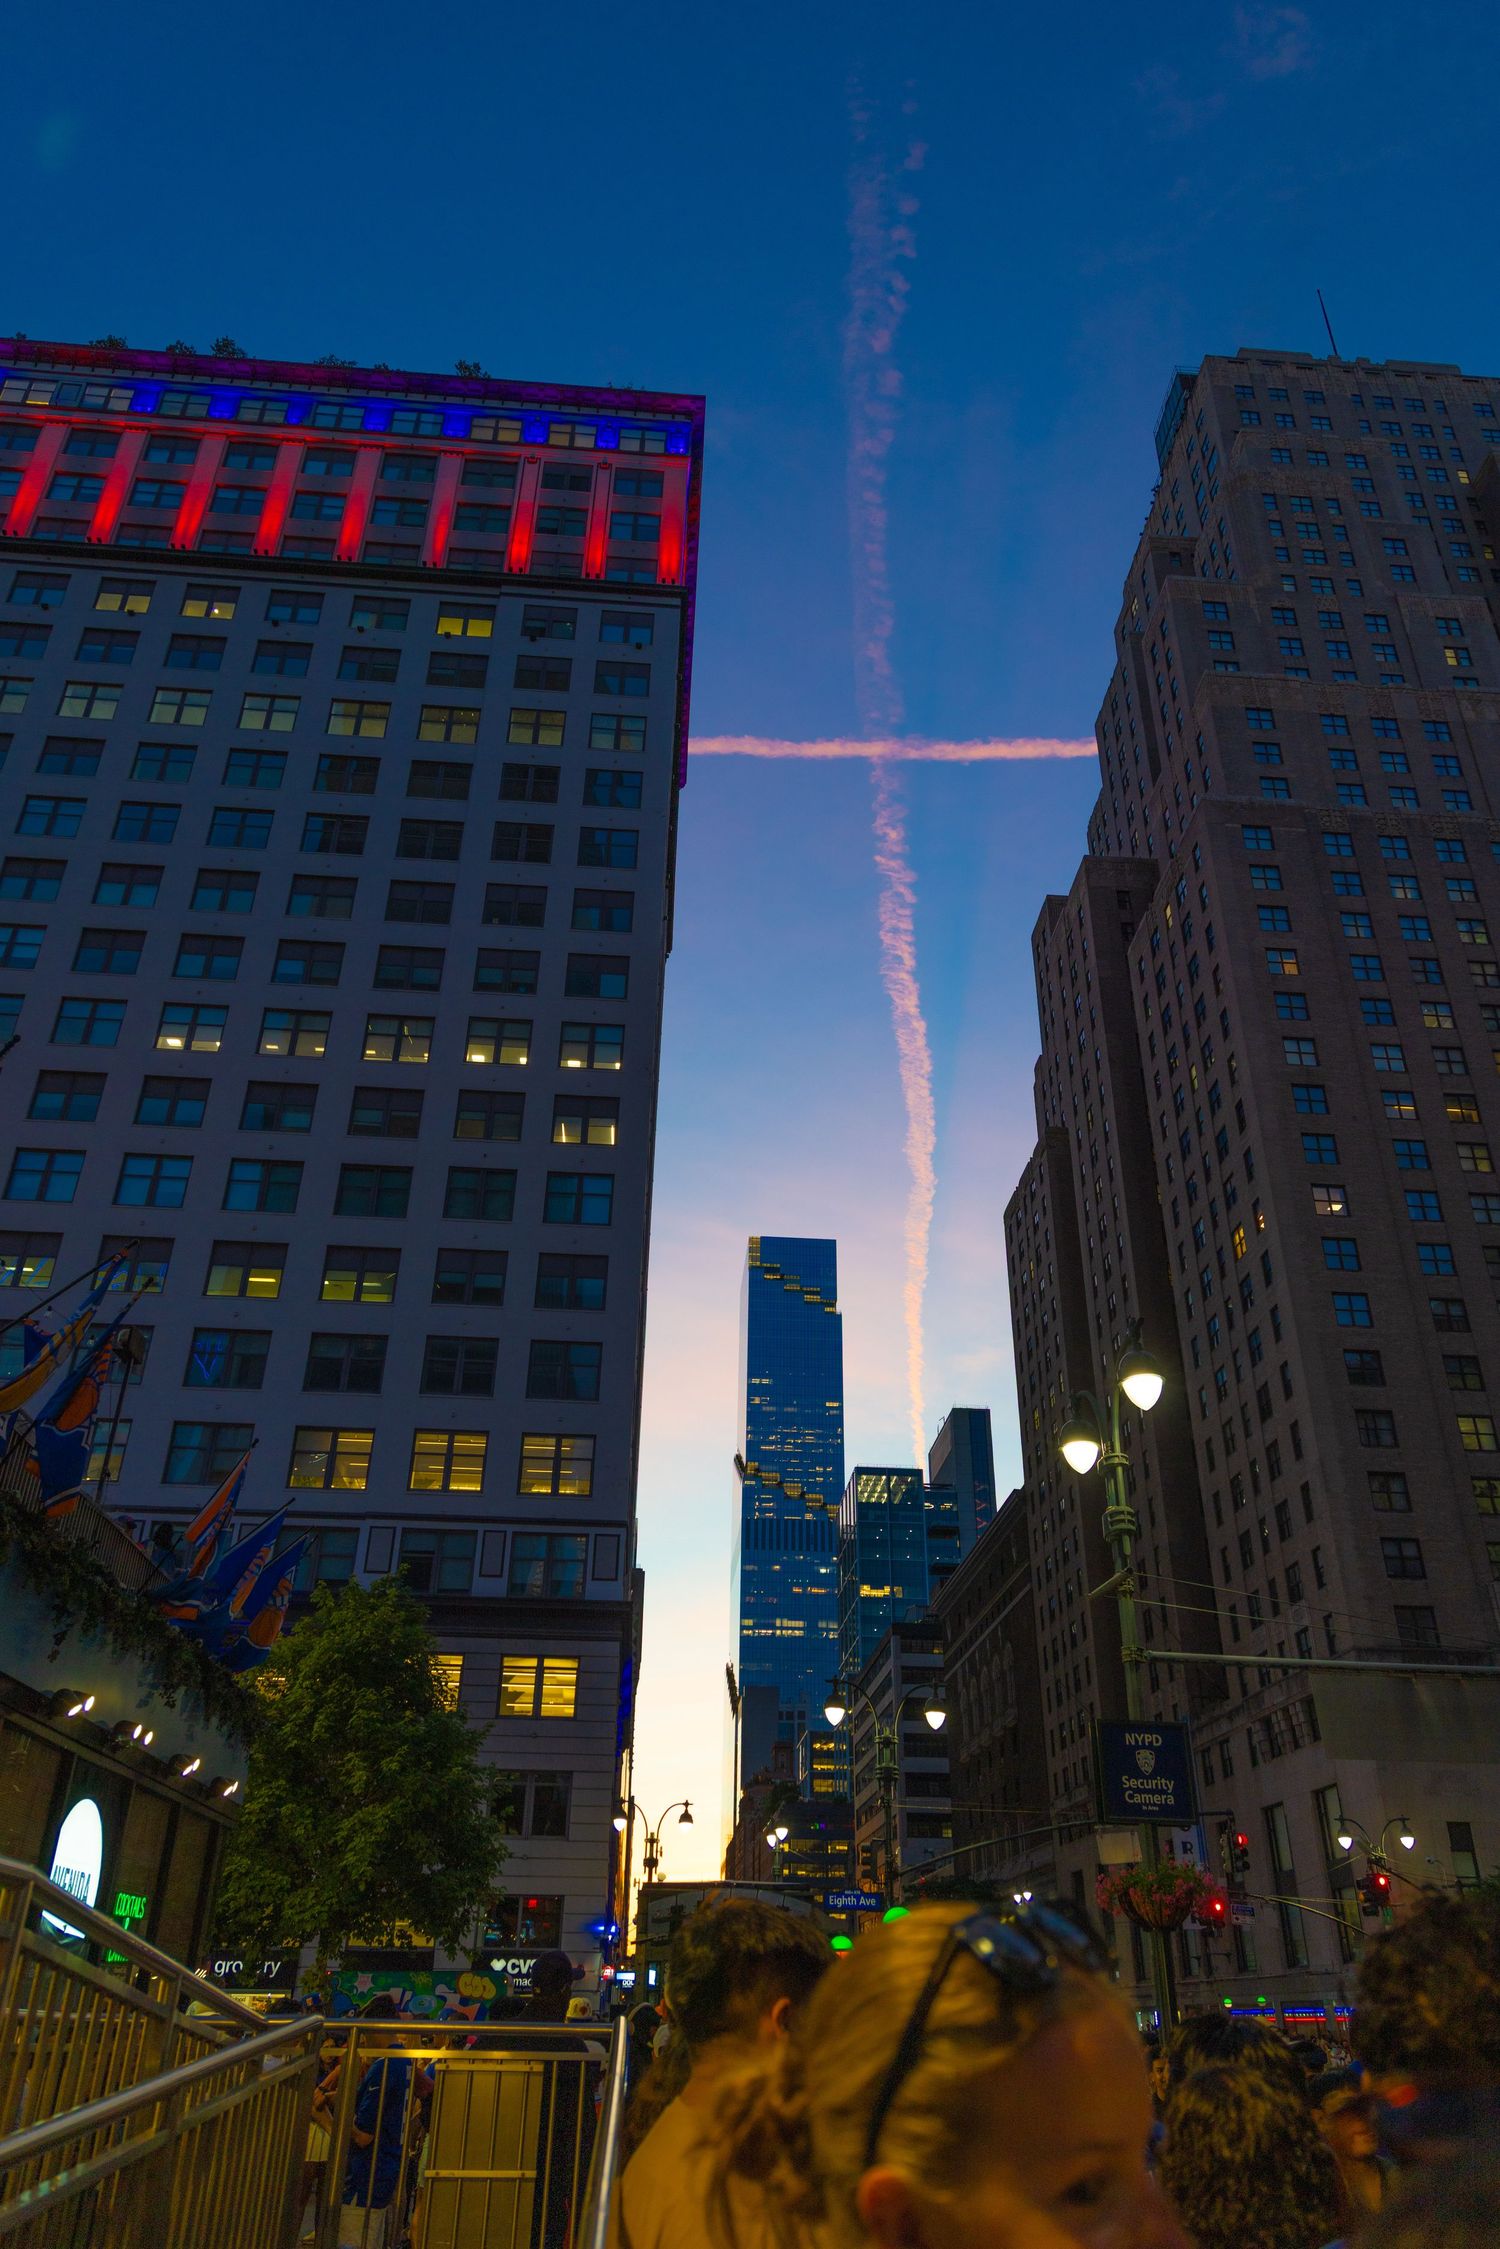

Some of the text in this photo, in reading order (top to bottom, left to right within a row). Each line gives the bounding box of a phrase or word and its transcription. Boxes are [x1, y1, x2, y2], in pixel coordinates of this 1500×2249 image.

[1125, 1733, 1163, 1746] NYPD
[1121, 1775, 1175, 1793] Security
[1124, 1790, 1175, 1805] Camera
[829, 1895, 877, 1908] Eighth Ave
[214, 1960, 281, 1978] grory
